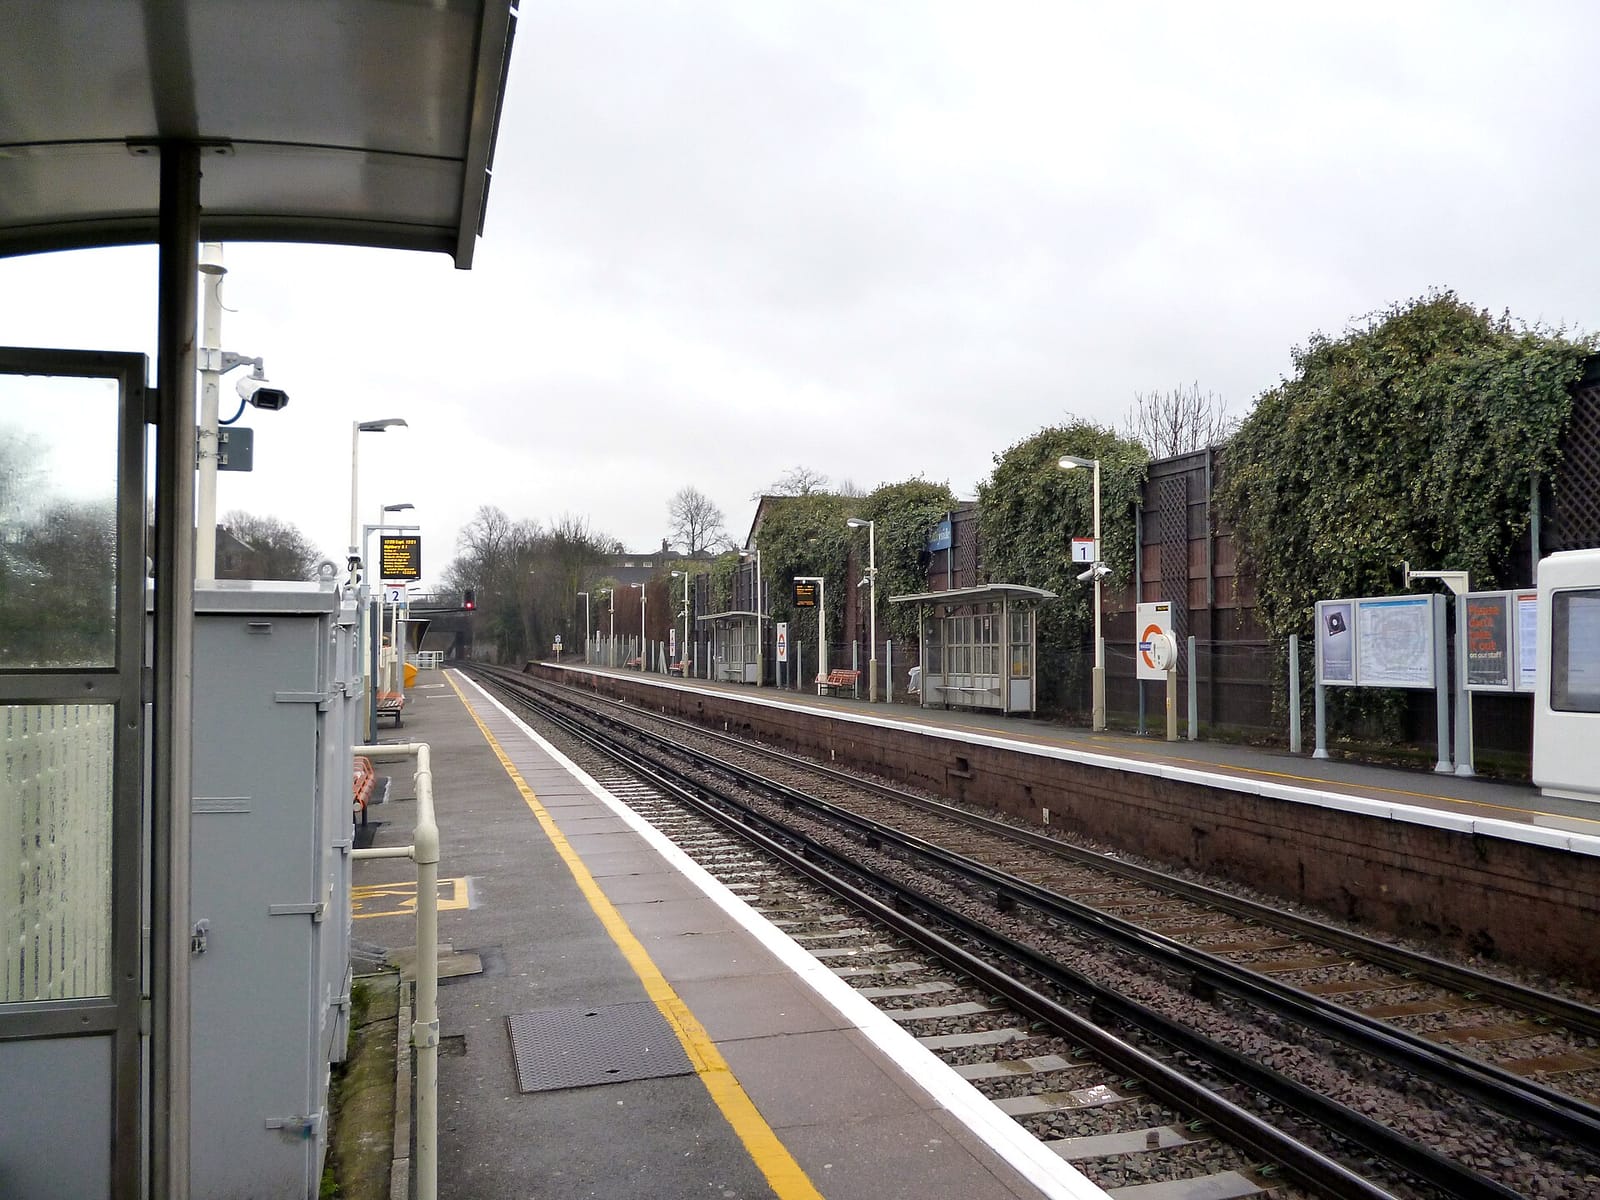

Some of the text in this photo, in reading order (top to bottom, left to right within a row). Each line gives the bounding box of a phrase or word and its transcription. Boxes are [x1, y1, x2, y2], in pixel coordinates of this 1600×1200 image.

[1080, 547, 1086, 560] 1
[392, 591, 399, 601] 2
[1479, 641, 1496, 651] out
